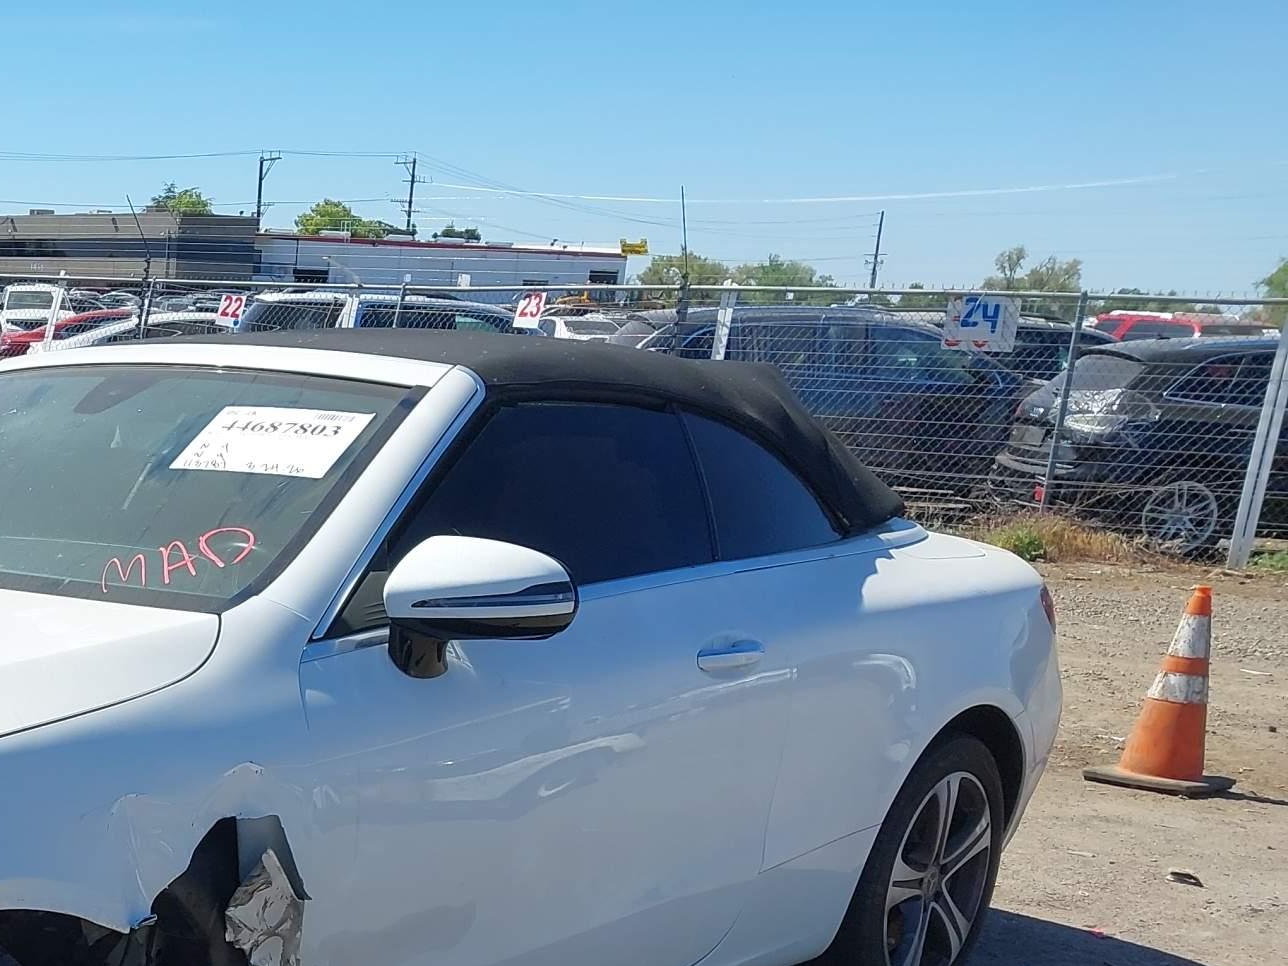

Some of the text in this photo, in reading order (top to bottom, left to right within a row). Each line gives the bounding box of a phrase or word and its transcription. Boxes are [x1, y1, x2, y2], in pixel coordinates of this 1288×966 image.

[219, 294, 244, 318] 22
[517, 293, 542, 318] 23
[960, 297, 1001, 334] 24
[221, 419, 342, 438] 44687803
